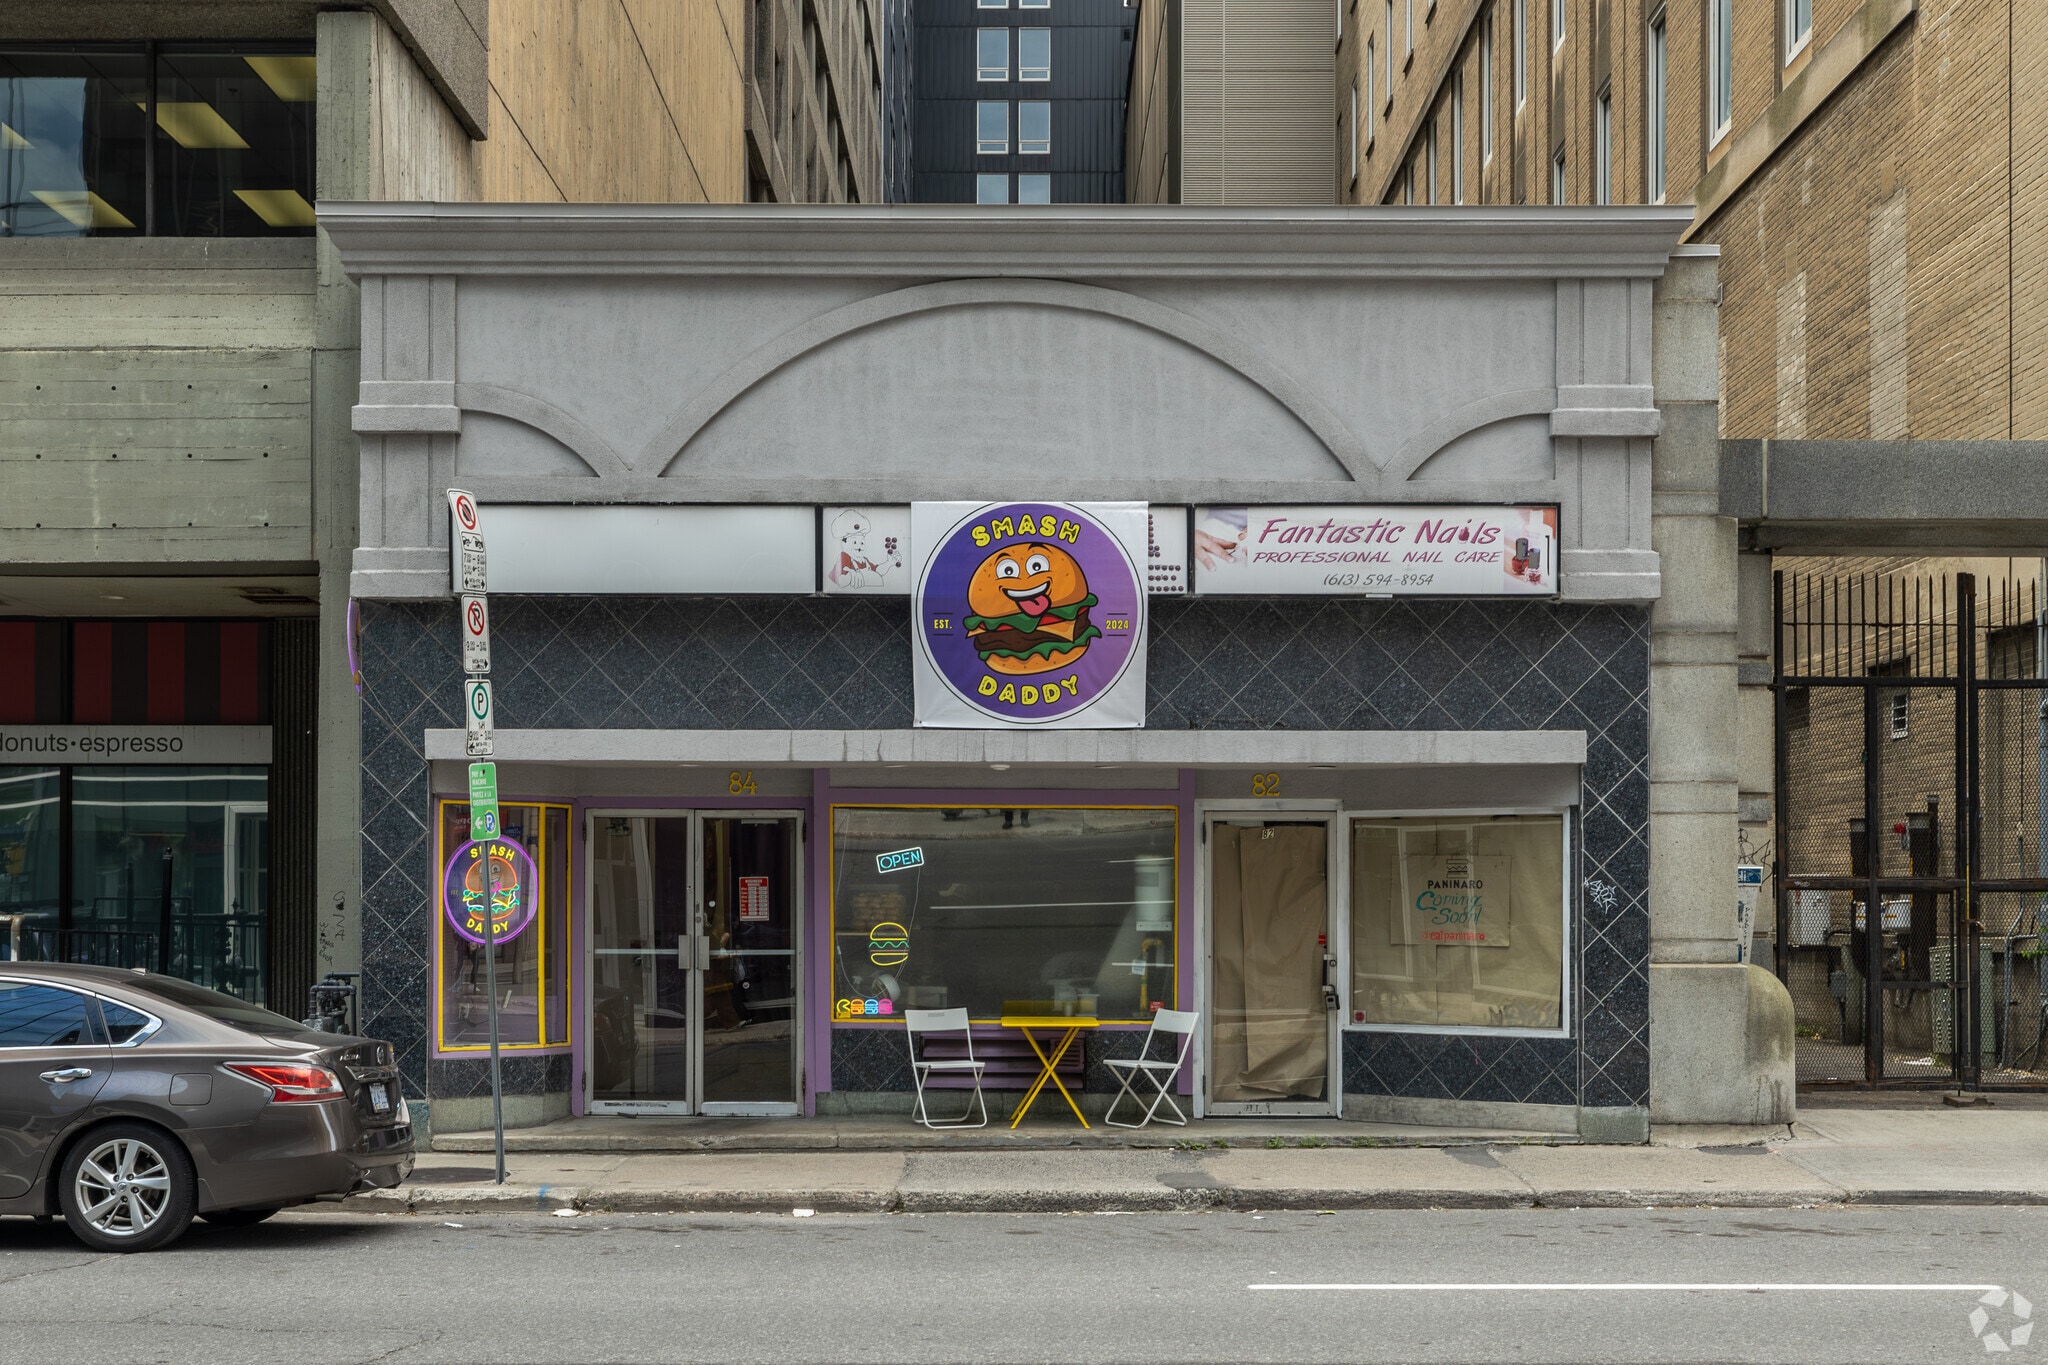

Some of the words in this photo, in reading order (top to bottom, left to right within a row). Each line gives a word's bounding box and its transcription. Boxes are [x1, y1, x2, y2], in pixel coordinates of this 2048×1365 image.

[971, 514, 1081, 547] SMASH
[1257, 517, 1405, 545] Fantastic
[1413, 517, 1502, 545] Nails
[1252, 551, 1392, 564] PROFESSIONAL
[1402, 551, 1444, 564] NAIL
[1454, 550, 1503, 564] CARE
[1323, 573, 1360, 586] (613)
[1363, 573, 1435, 586] 594-8954
[933, 619, 953, 630] EST.
[1105, 619, 1129, 630] 2024
[977, 674, 1079, 705] DADDY
[728, 770, 757, 795] 84
[1252, 773, 1281, 797] 82
[1262, 828, 1275, 839] 82
[879, 850, 922, 870] OPEN
[1427, 880, 1483, 889] PANINARO
[1415, 890, 1483, 912] Coming
[466, 918, 509, 934] DADY
